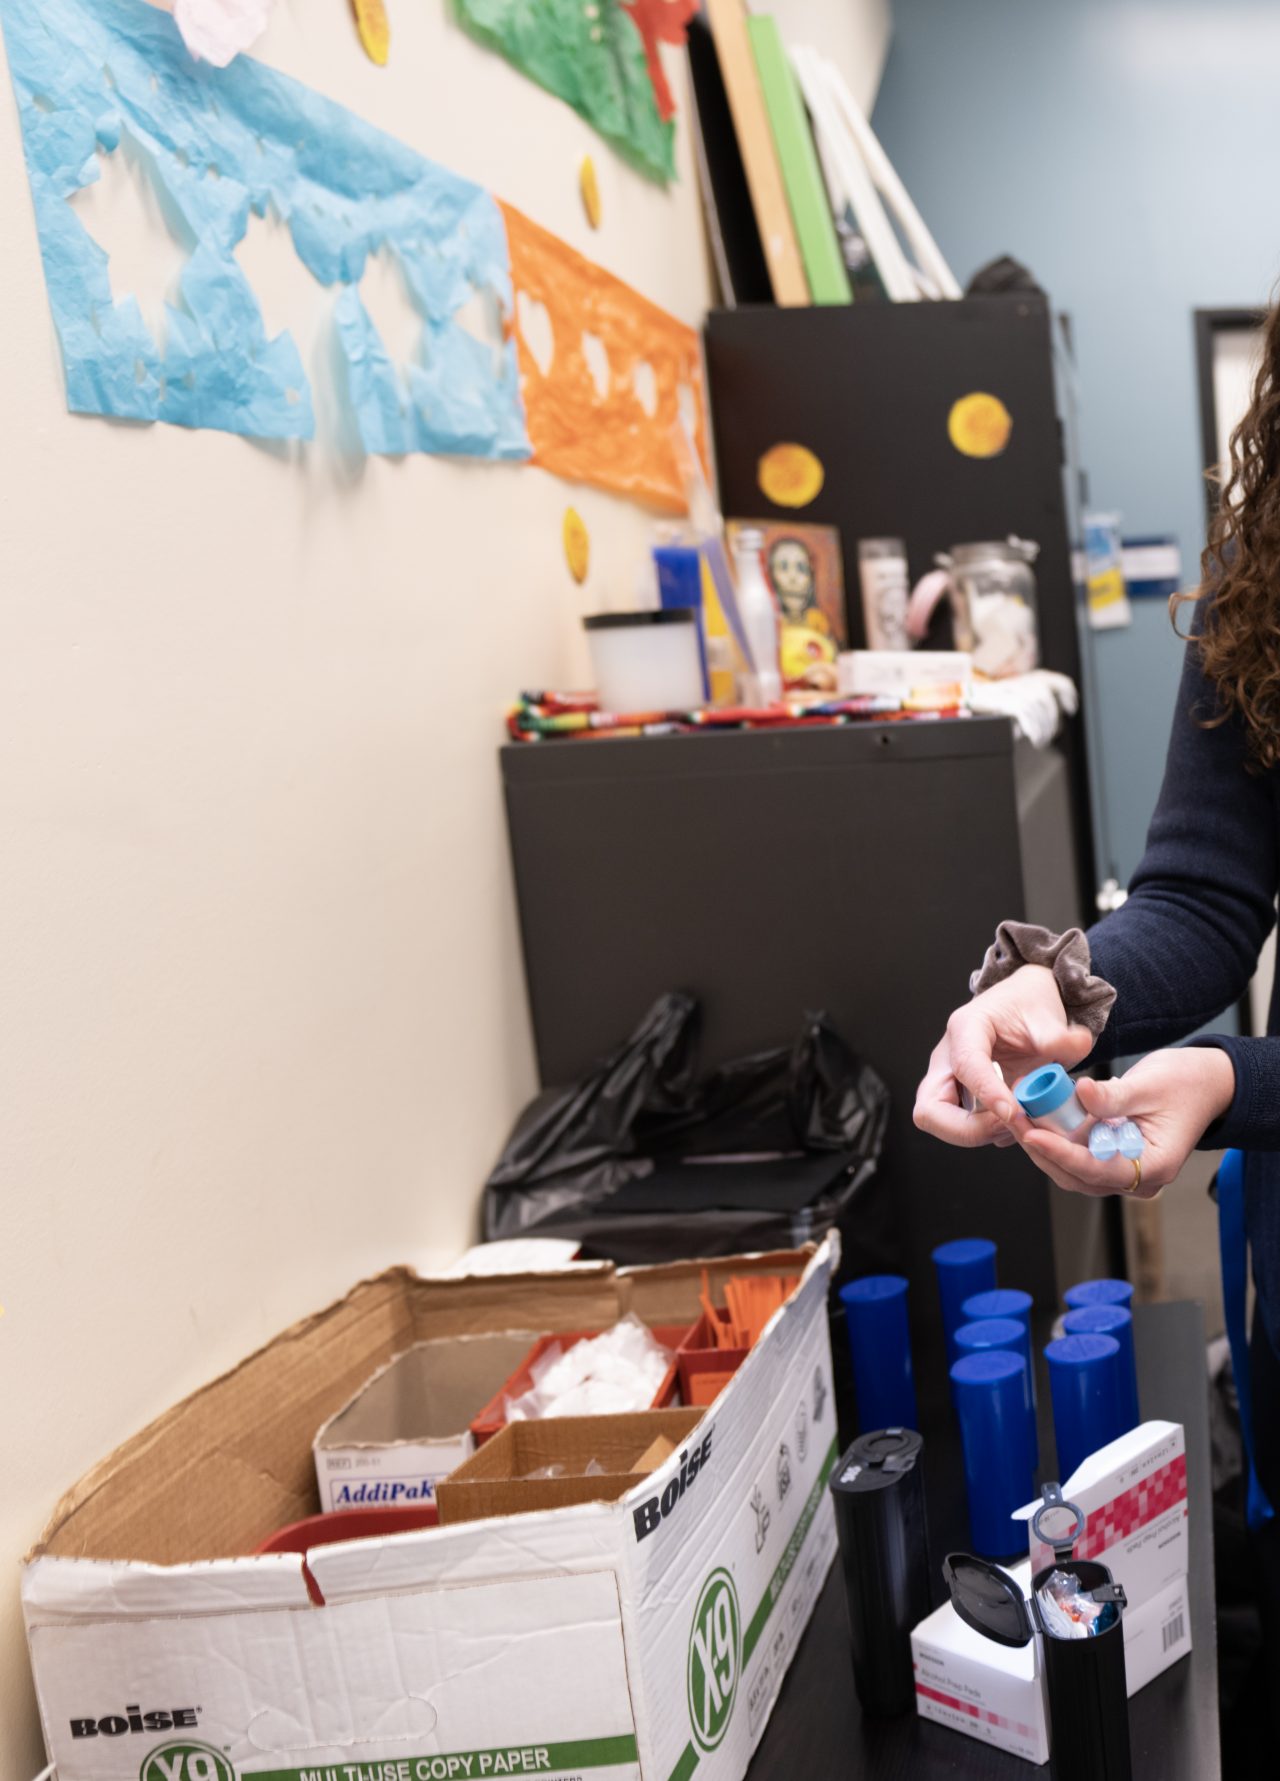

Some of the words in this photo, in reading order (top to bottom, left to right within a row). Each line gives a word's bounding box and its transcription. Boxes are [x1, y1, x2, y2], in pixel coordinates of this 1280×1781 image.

[336, 1480, 433, 1503] AddiPak
[415, 1754, 474, 1781] COPY
[478, 1747, 551, 1775] PAPER
